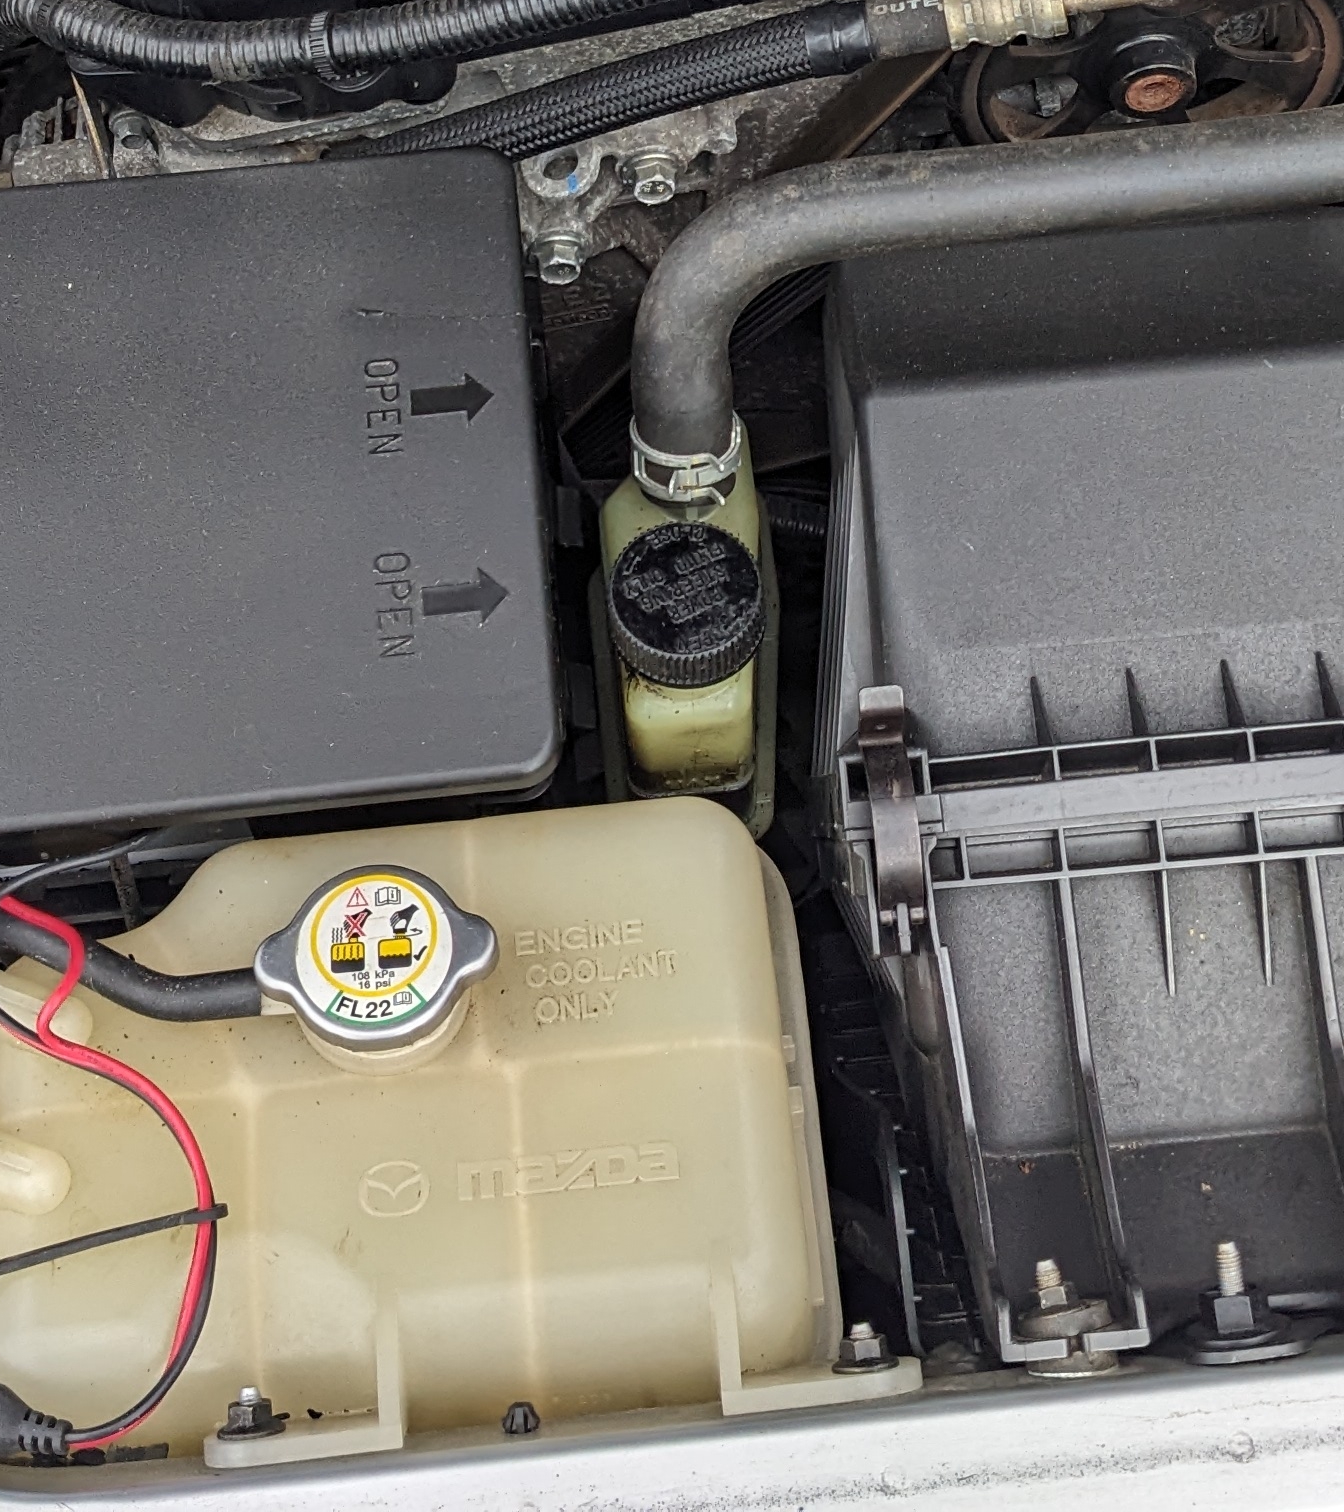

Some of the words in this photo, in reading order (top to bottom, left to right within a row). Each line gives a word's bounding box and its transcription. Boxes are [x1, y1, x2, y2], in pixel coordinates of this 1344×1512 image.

[364, 357, 404, 457] OPEN
[374, 551, 416, 659] OPEN
[513, 919, 644, 957] ENGINE
[351, 971, 371, 981] 108
[374, 969, 396, 979] kPa
[358, 980, 371, 990] 16
[375, 978, 392, 990] psi
[525, 949, 678, 988] COOLANT
[336, 996, 394, 1019] FL22
[535, 990, 620, 1024] ONLY
